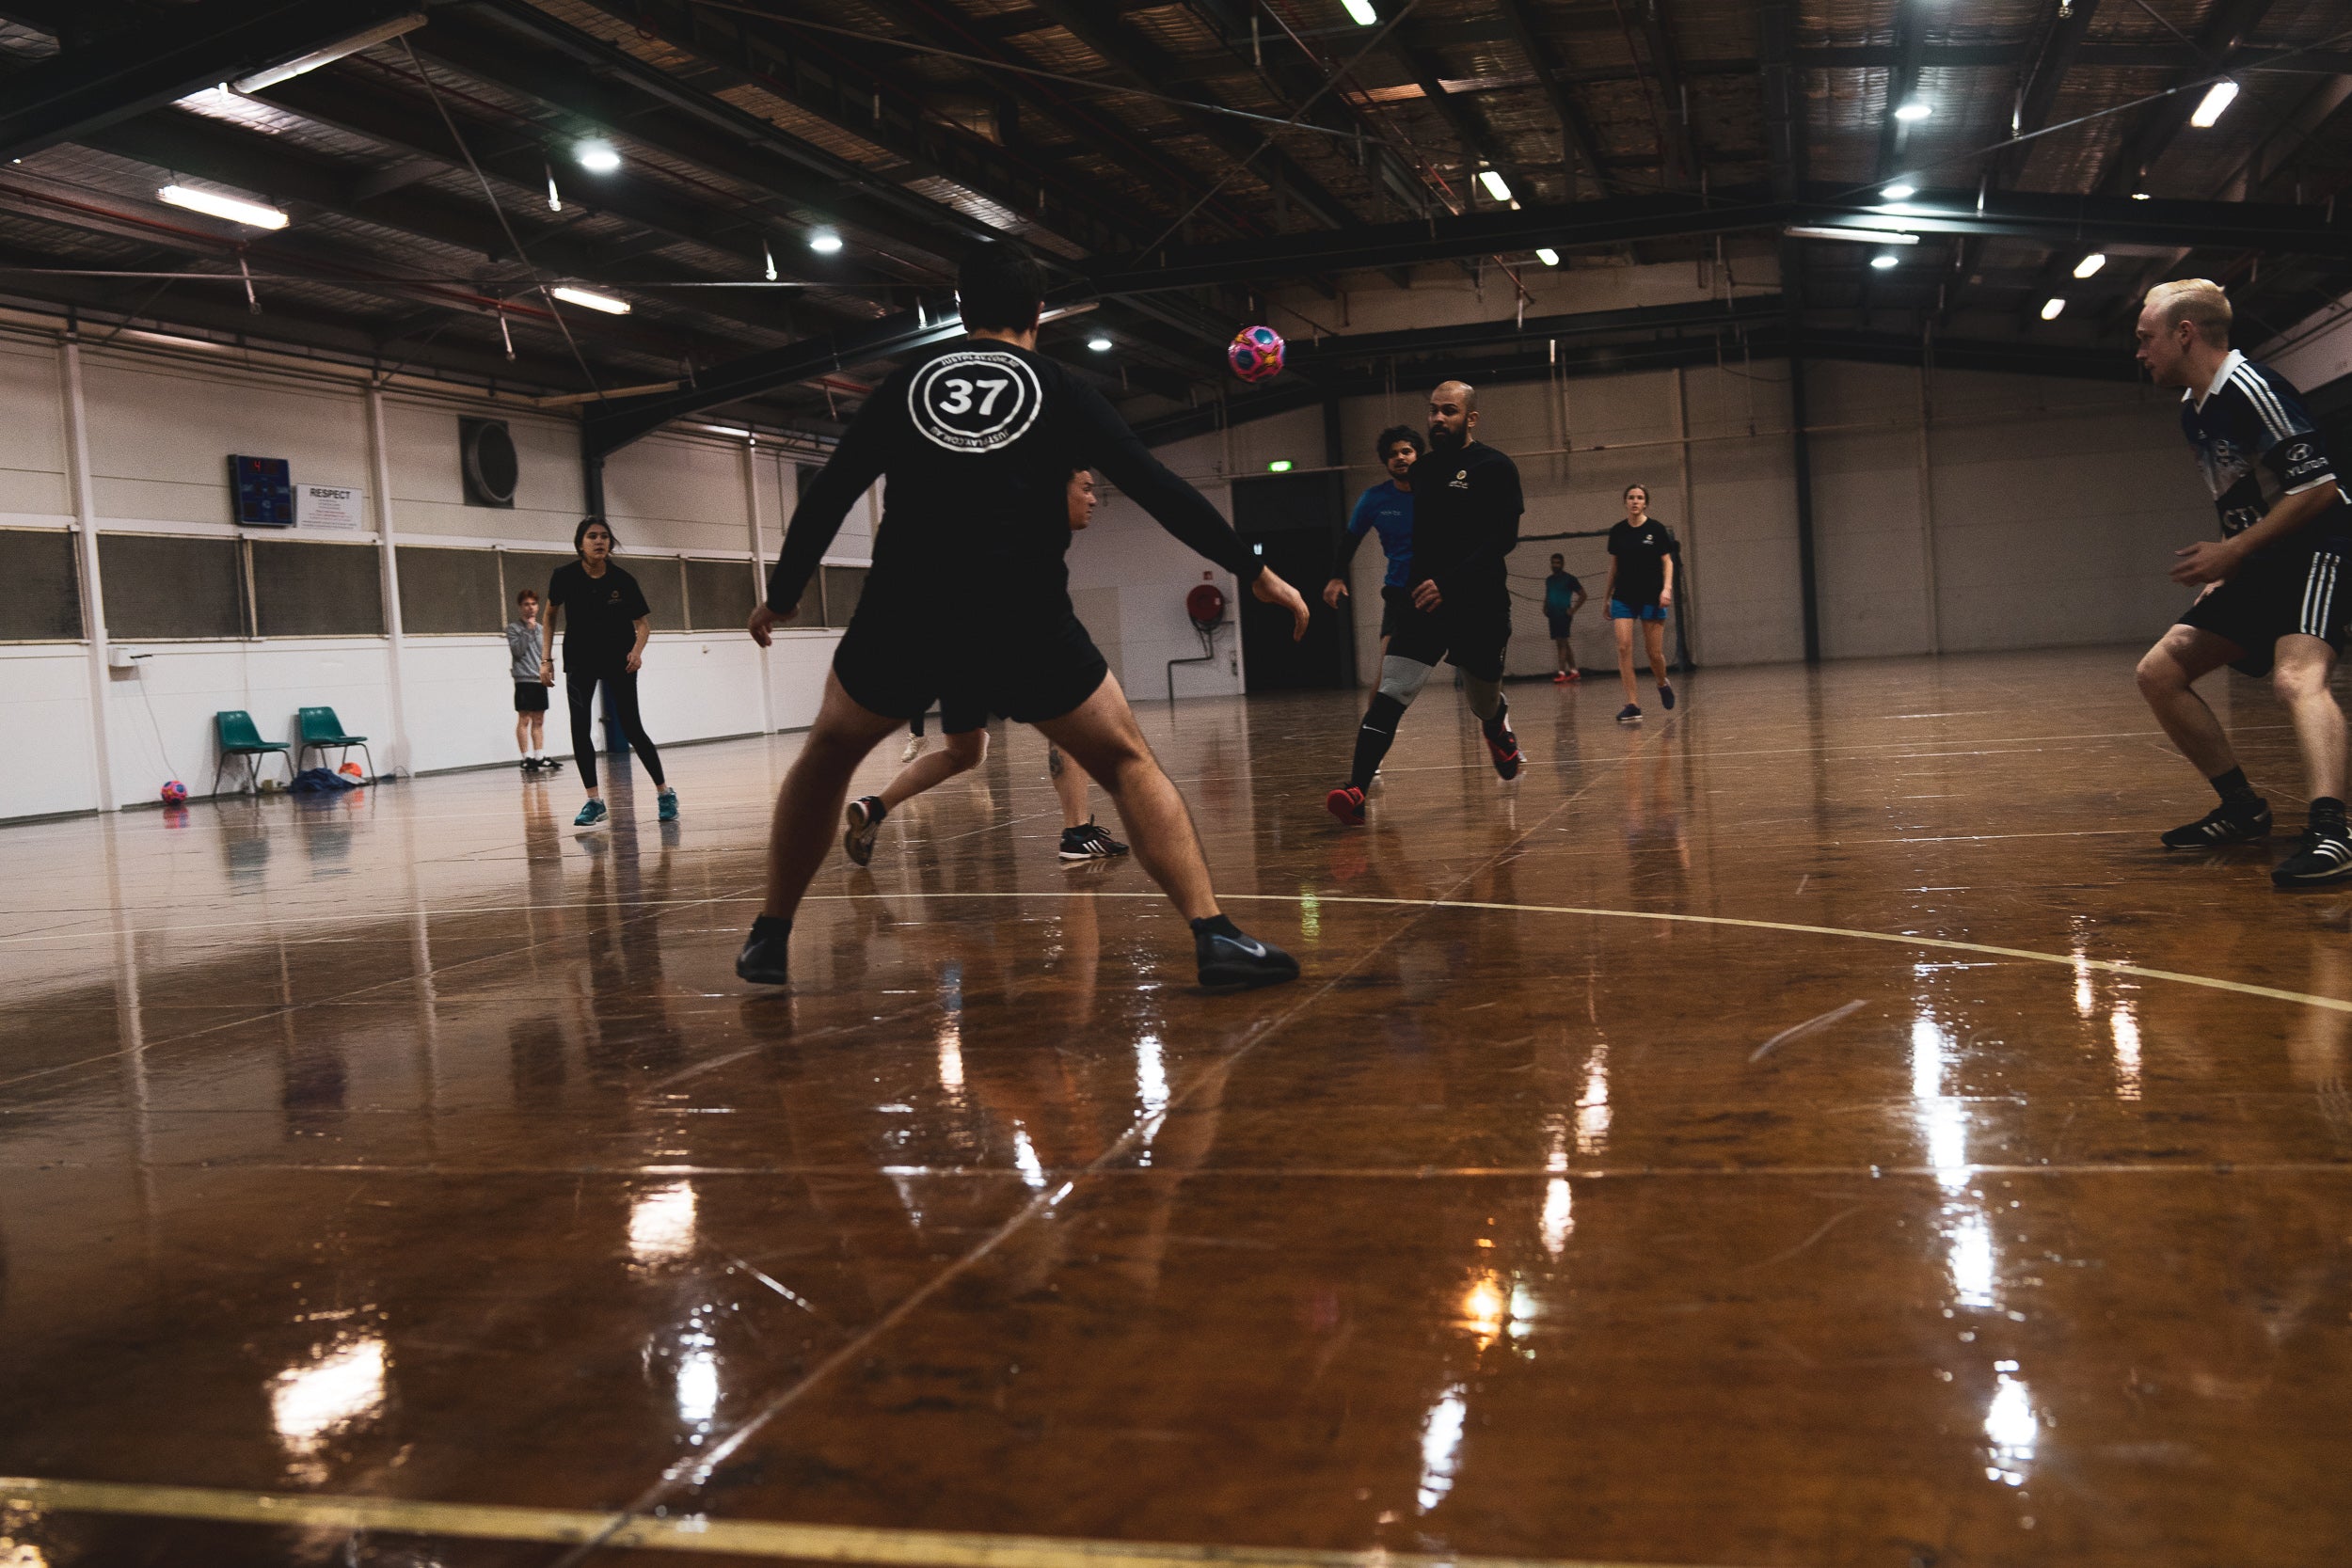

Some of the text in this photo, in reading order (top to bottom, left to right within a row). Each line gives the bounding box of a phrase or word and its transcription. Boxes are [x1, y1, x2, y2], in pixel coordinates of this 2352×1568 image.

[939, 378, 1009, 416] 37
[254, 460, 261, 472] 4
[310, 487, 352, 499] RESPECT
